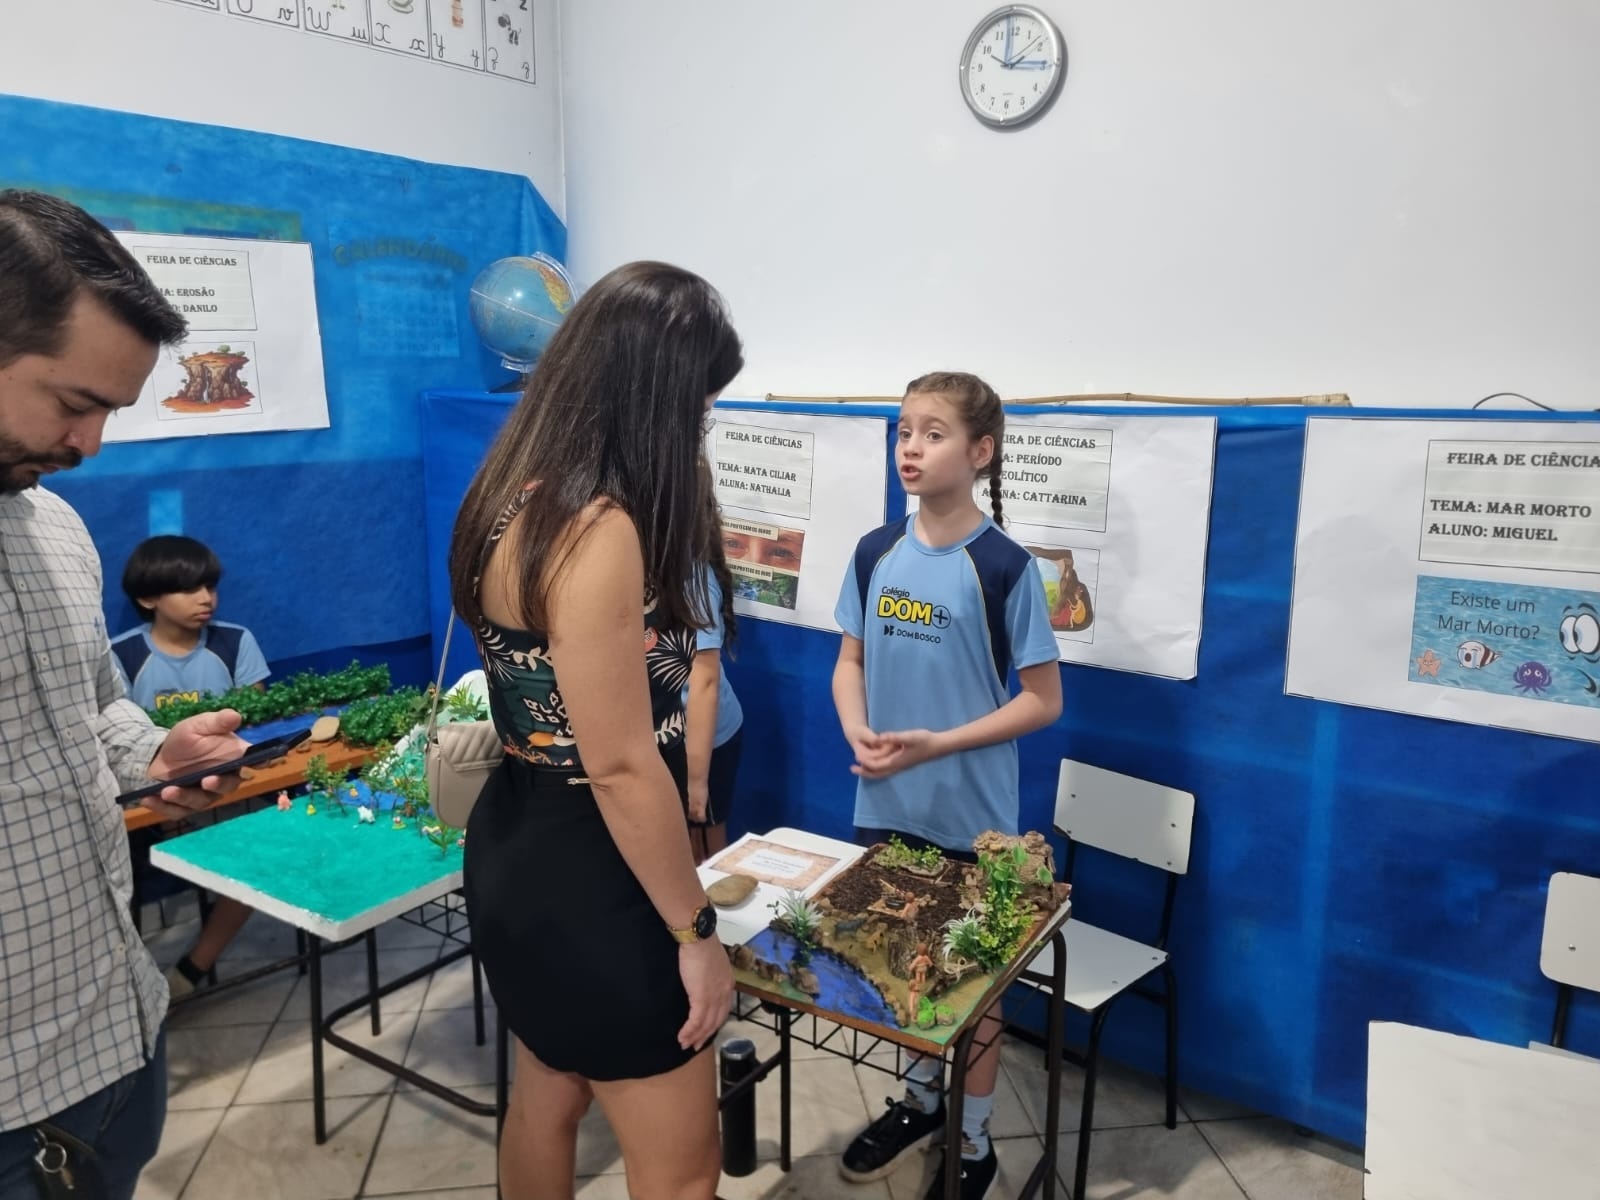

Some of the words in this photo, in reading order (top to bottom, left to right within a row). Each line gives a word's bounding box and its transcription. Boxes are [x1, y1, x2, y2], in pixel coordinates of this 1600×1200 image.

[146, 255, 176, 264] FEIRA
[179, 256, 192, 265] DE
[194, 256, 237, 266] CIÊNCIAS
[176, 286, 215, 297] EROSÃO
[183, 304, 218, 313] DANILO
[725, 431, 750, 442] FEIRA
[752, 434, 763, 444] DE
[764, 435, 802, 449] CIÊNCIAS
[1002, 434, 1024, 445] IRA
[1028, 435, 1042, 445] DE
[1044, 434, 1096, 449] CIÊNCIAS
[1016, 453, 1062, 466] PERÍODO
[1447, 452, 1498, 465] FEIRA
[1503, 453, 1527, 466] DE
[1531, 452, 1600, 468] CIÊNCIA
[717, 461, 742, 473] TEMA:
[744, 465, 768, 477] MATA
[769, 469, 797, 482] CILIAR
[1001, 469, 1048, 483] EOLÍTICO
[719, 478, 748, 490] ALUNA:
[750, 482, 791, 497] NATHALIA
[981, 487, 1021, 500] ANA:
[1023, 491, 1087, 506] CATTARINA
[1430, 499, 1482, 513] TEMA:
[1485, 501, 1526, 516] MAR
[1529, 503, 1592, 518] MORTO
[1428, 523, 1488, 538] ALUNO:
[1491, 526, 1558, 541] MIGUEL
[881, 586, 910, 598] Colégio
[1451, 591, 1501, 610] Existe
[1506, 599, 1536, 613] um
[1438, 614, 1472, 632] Mar
[1477, 619, 1540, 640] Morto?
[897, 629, 913, 638] DOM
[914, 632, 941, 644] BOSCO
